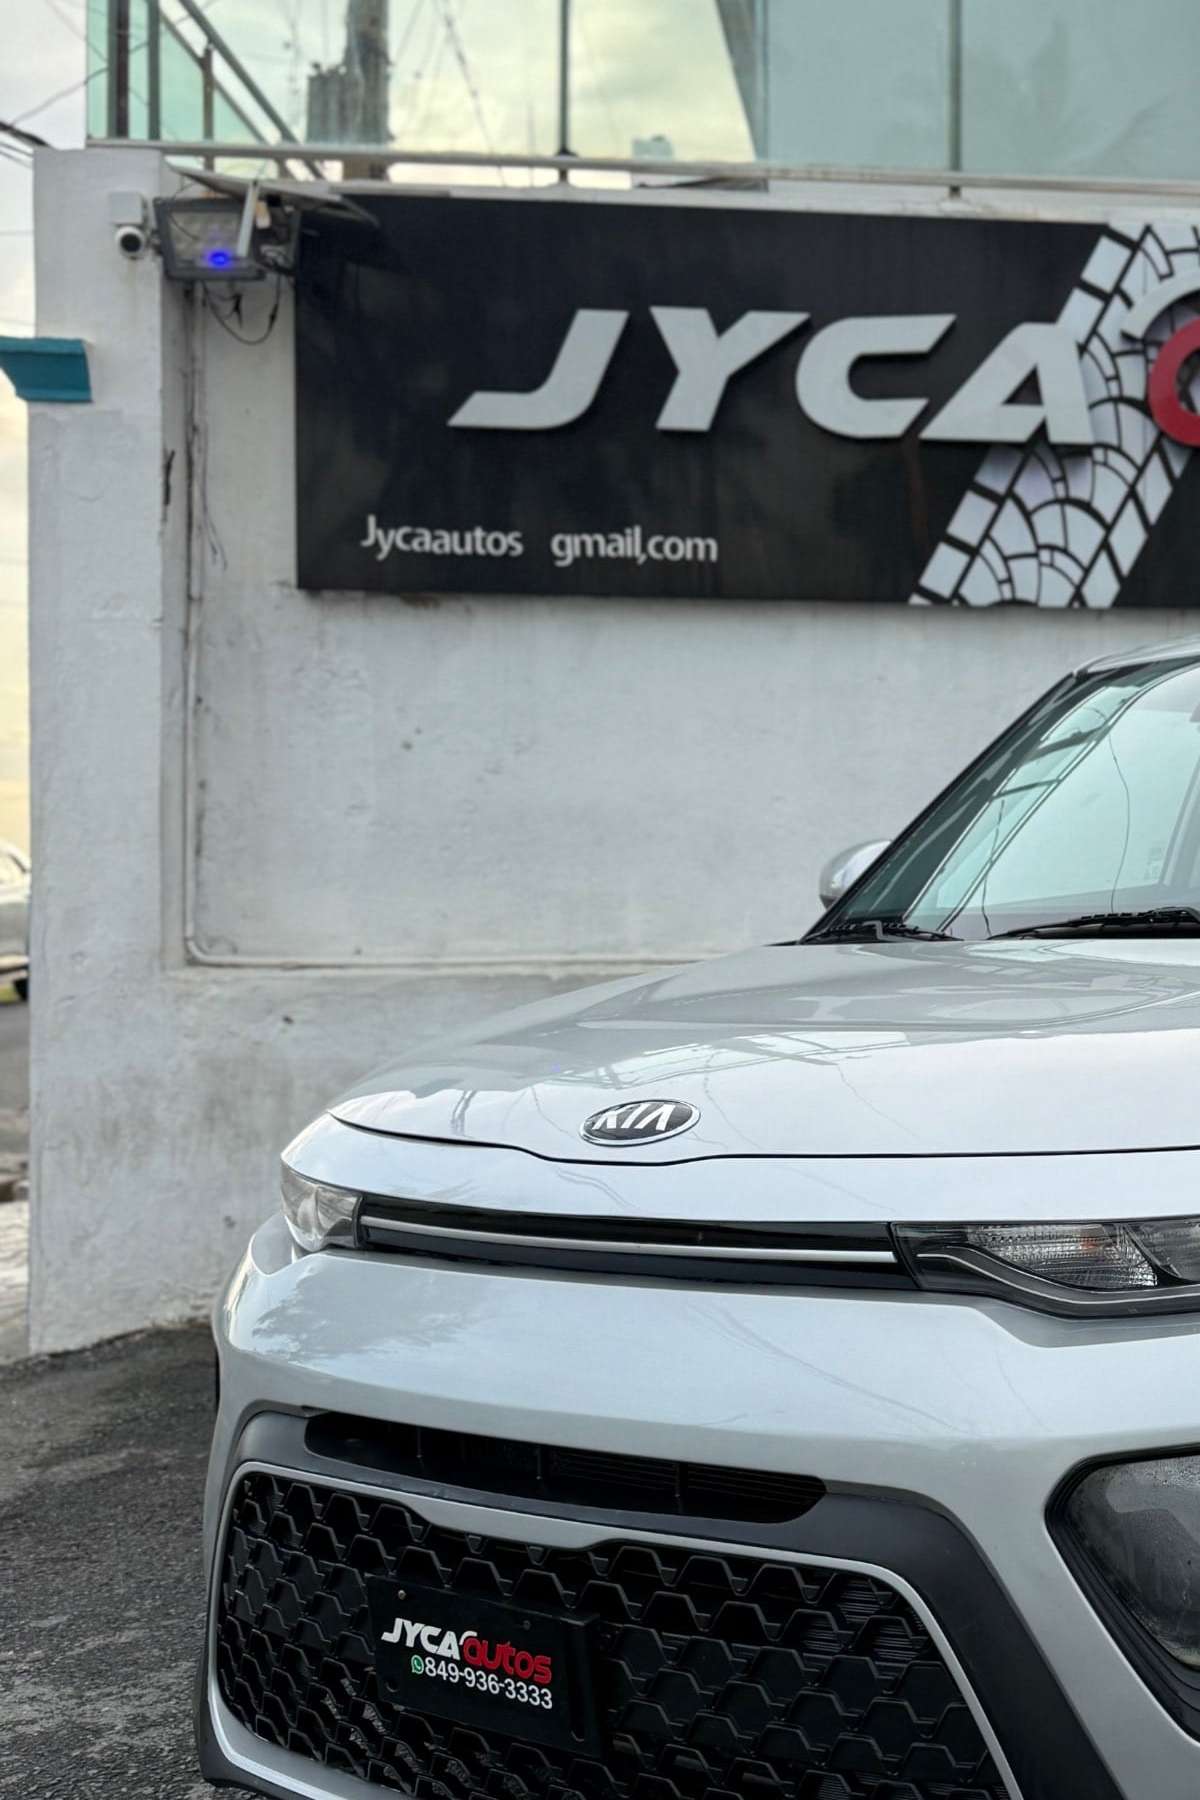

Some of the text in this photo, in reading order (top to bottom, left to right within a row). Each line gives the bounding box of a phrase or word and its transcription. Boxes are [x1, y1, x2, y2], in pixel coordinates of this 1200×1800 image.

[361, 514, 524, 561] Jycaautos
[591, 1103, 676, 1131] KIA
[424, 1656, 553, 1710] 849-936-3333
